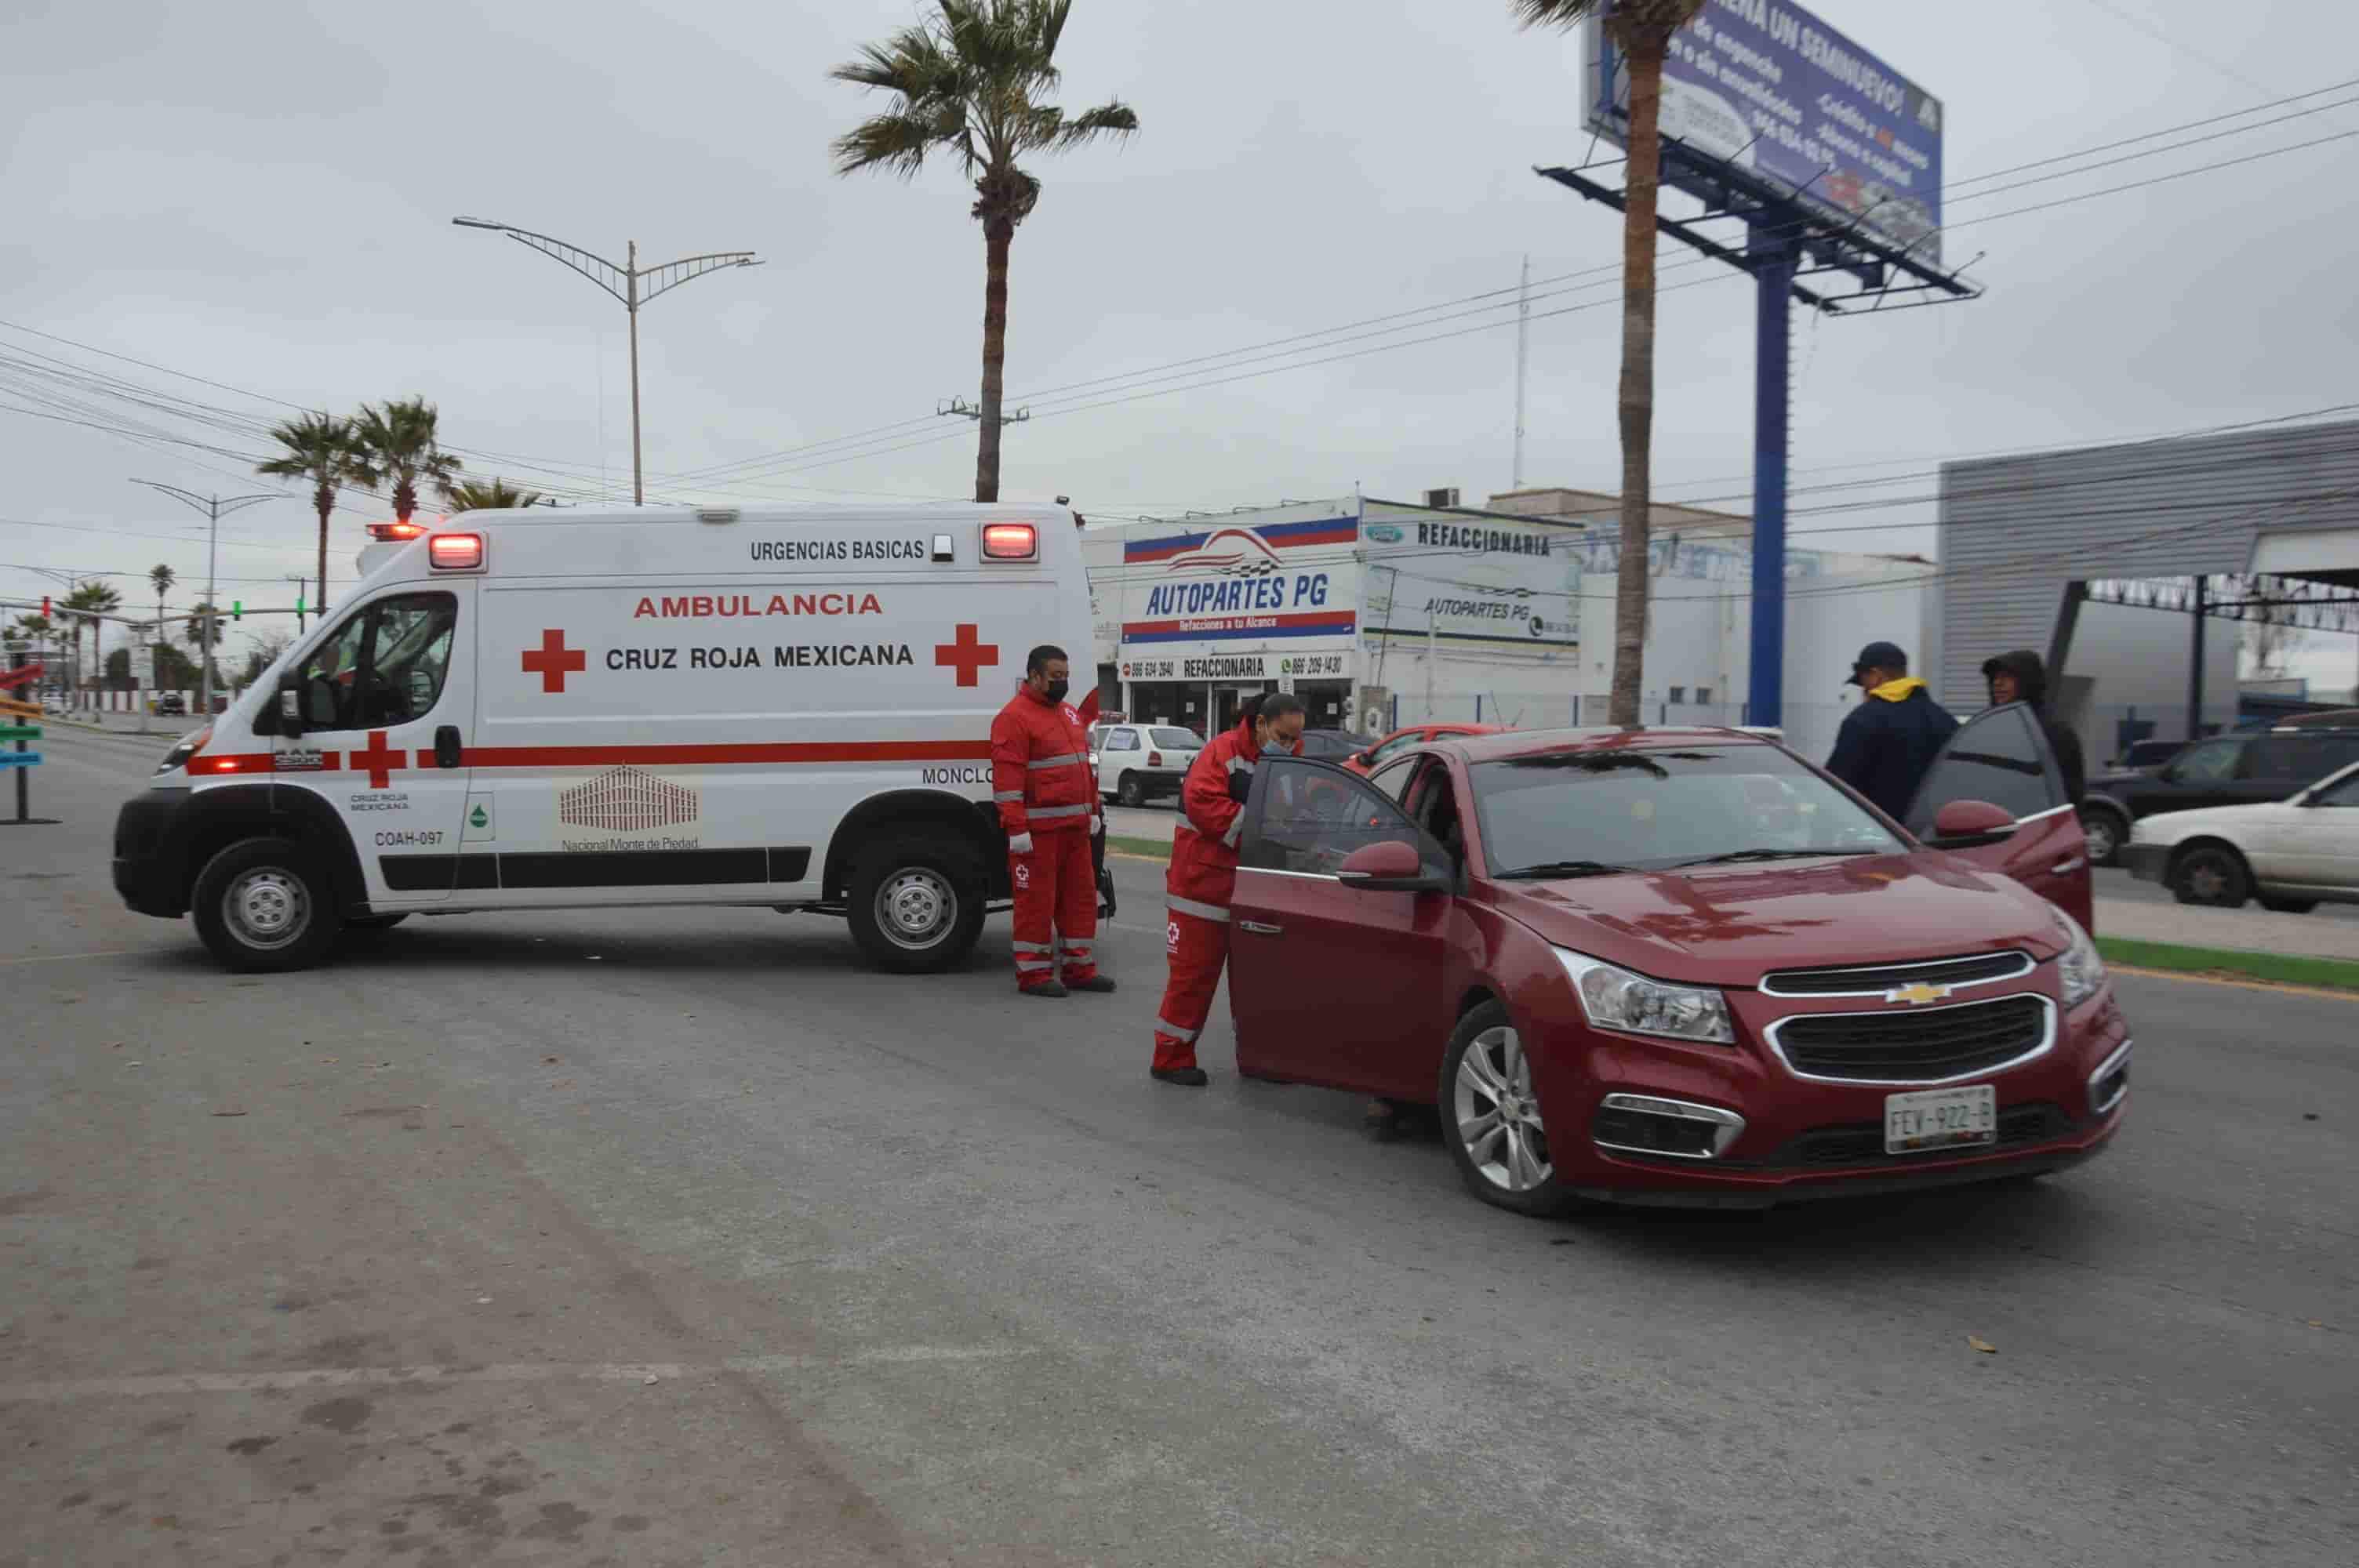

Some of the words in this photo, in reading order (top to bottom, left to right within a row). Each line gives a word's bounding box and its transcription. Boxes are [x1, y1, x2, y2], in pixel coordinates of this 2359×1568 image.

[751, 540, 847, 560] URGENCIAS
[852, 540, 924, 559] BASICAS
[1418, 523, 1550, 556] REFACCIONARIA
[1147, 576, 1285, 615] AUTOPARTES
[1294, 573, 1328, 606] PG
[633, 593, 883, 618] AMBULANCIA
[1423, 598, 1508, 619] AUTOPARTES
[1510, 604, 1530, 620] PG
[1180, 619, 1223, 632] Refacciones
[1234, 619, 1243, 629] tu
[1246, 616, 1277, 628] Alcance
[606, 648, 678, 670] CRUZ
[690, 647, 761, 668] ROJA
[774, 644, 914, 667] MEXICANA
[1183, 657, 1265, 678] REFACCIONARIA
[351, 794, 378, 803] CRUZ
[375, 831, 443, 847] COAH-097
[562, 838, 608, 852] Nacional
[609, 838, 644, 851] Monte
[647, 837, 660, 848] de
[663, 835, 698, 849] Piedad
